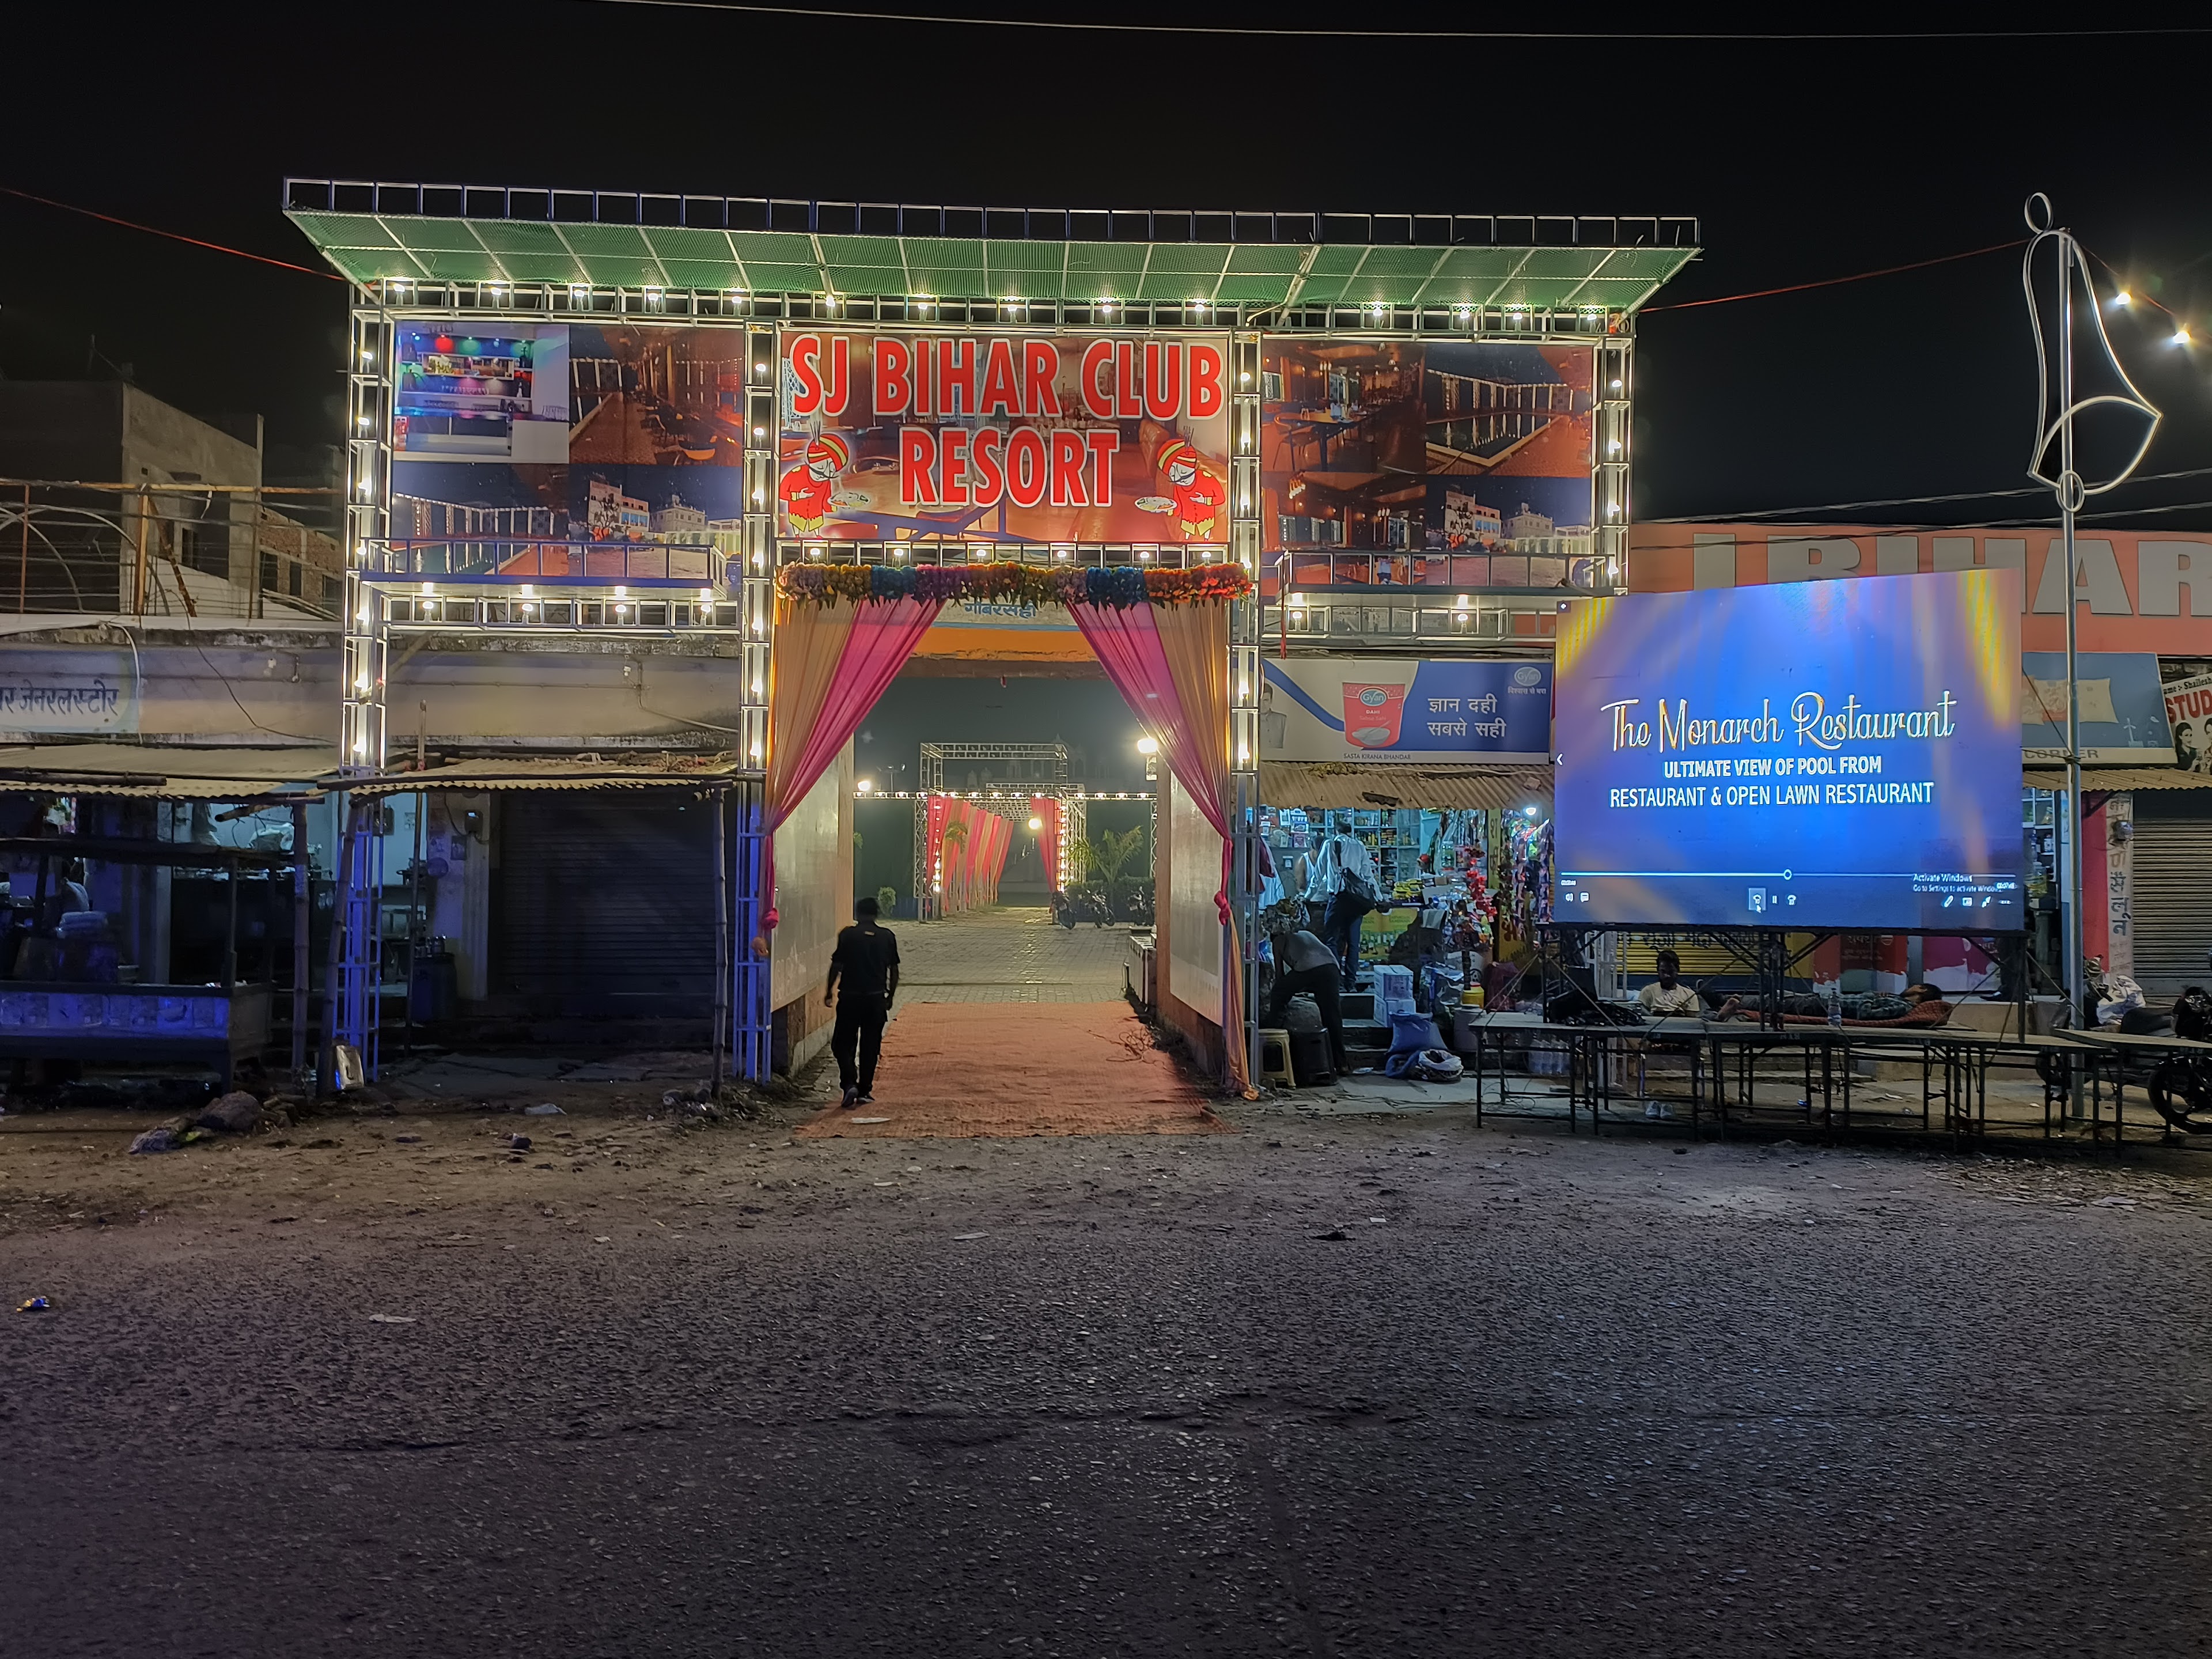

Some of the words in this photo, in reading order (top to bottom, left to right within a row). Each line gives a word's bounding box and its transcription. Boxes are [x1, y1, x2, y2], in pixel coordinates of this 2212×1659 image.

[789, 334, 850, 416] SJ
[873, 336, 1063, 417] BIHAR
[1081, 338, 1225, 421] CLUB
[899, 426, 1120, 508] RESORT
[1362, 691, 1384, 703] Gyan
[1427, 698, 1460, 713] ज्ञान
[1468, 693, 1498, 714] दही
[1427, 717, 1467, 736] सबसे
[1474, 717, 1506, 738] सही
[1600, 698, 1652, 752] The
[1658, 698, 1785, 753] Monarch
[1790, 690, 1957, 751] Restaurant
[1664, 759, 1731, 778] ULTIMATE
[1734, 758, 1772, 776] VIEW
[1775, 758, 1794, 775] OF
[1797, 756, 1836, 775] POOL
[1839, 755, 1882, 774] FROM
[1609, 786, 1706, 808] RESTAURANT
[1710, 786, 1722, 806] &
[1726, 786, 1770, 806] OPEN
[1775, 784, 1820, 805] LAWN
[1825, 781, 1935, 804] RESTAURANT
